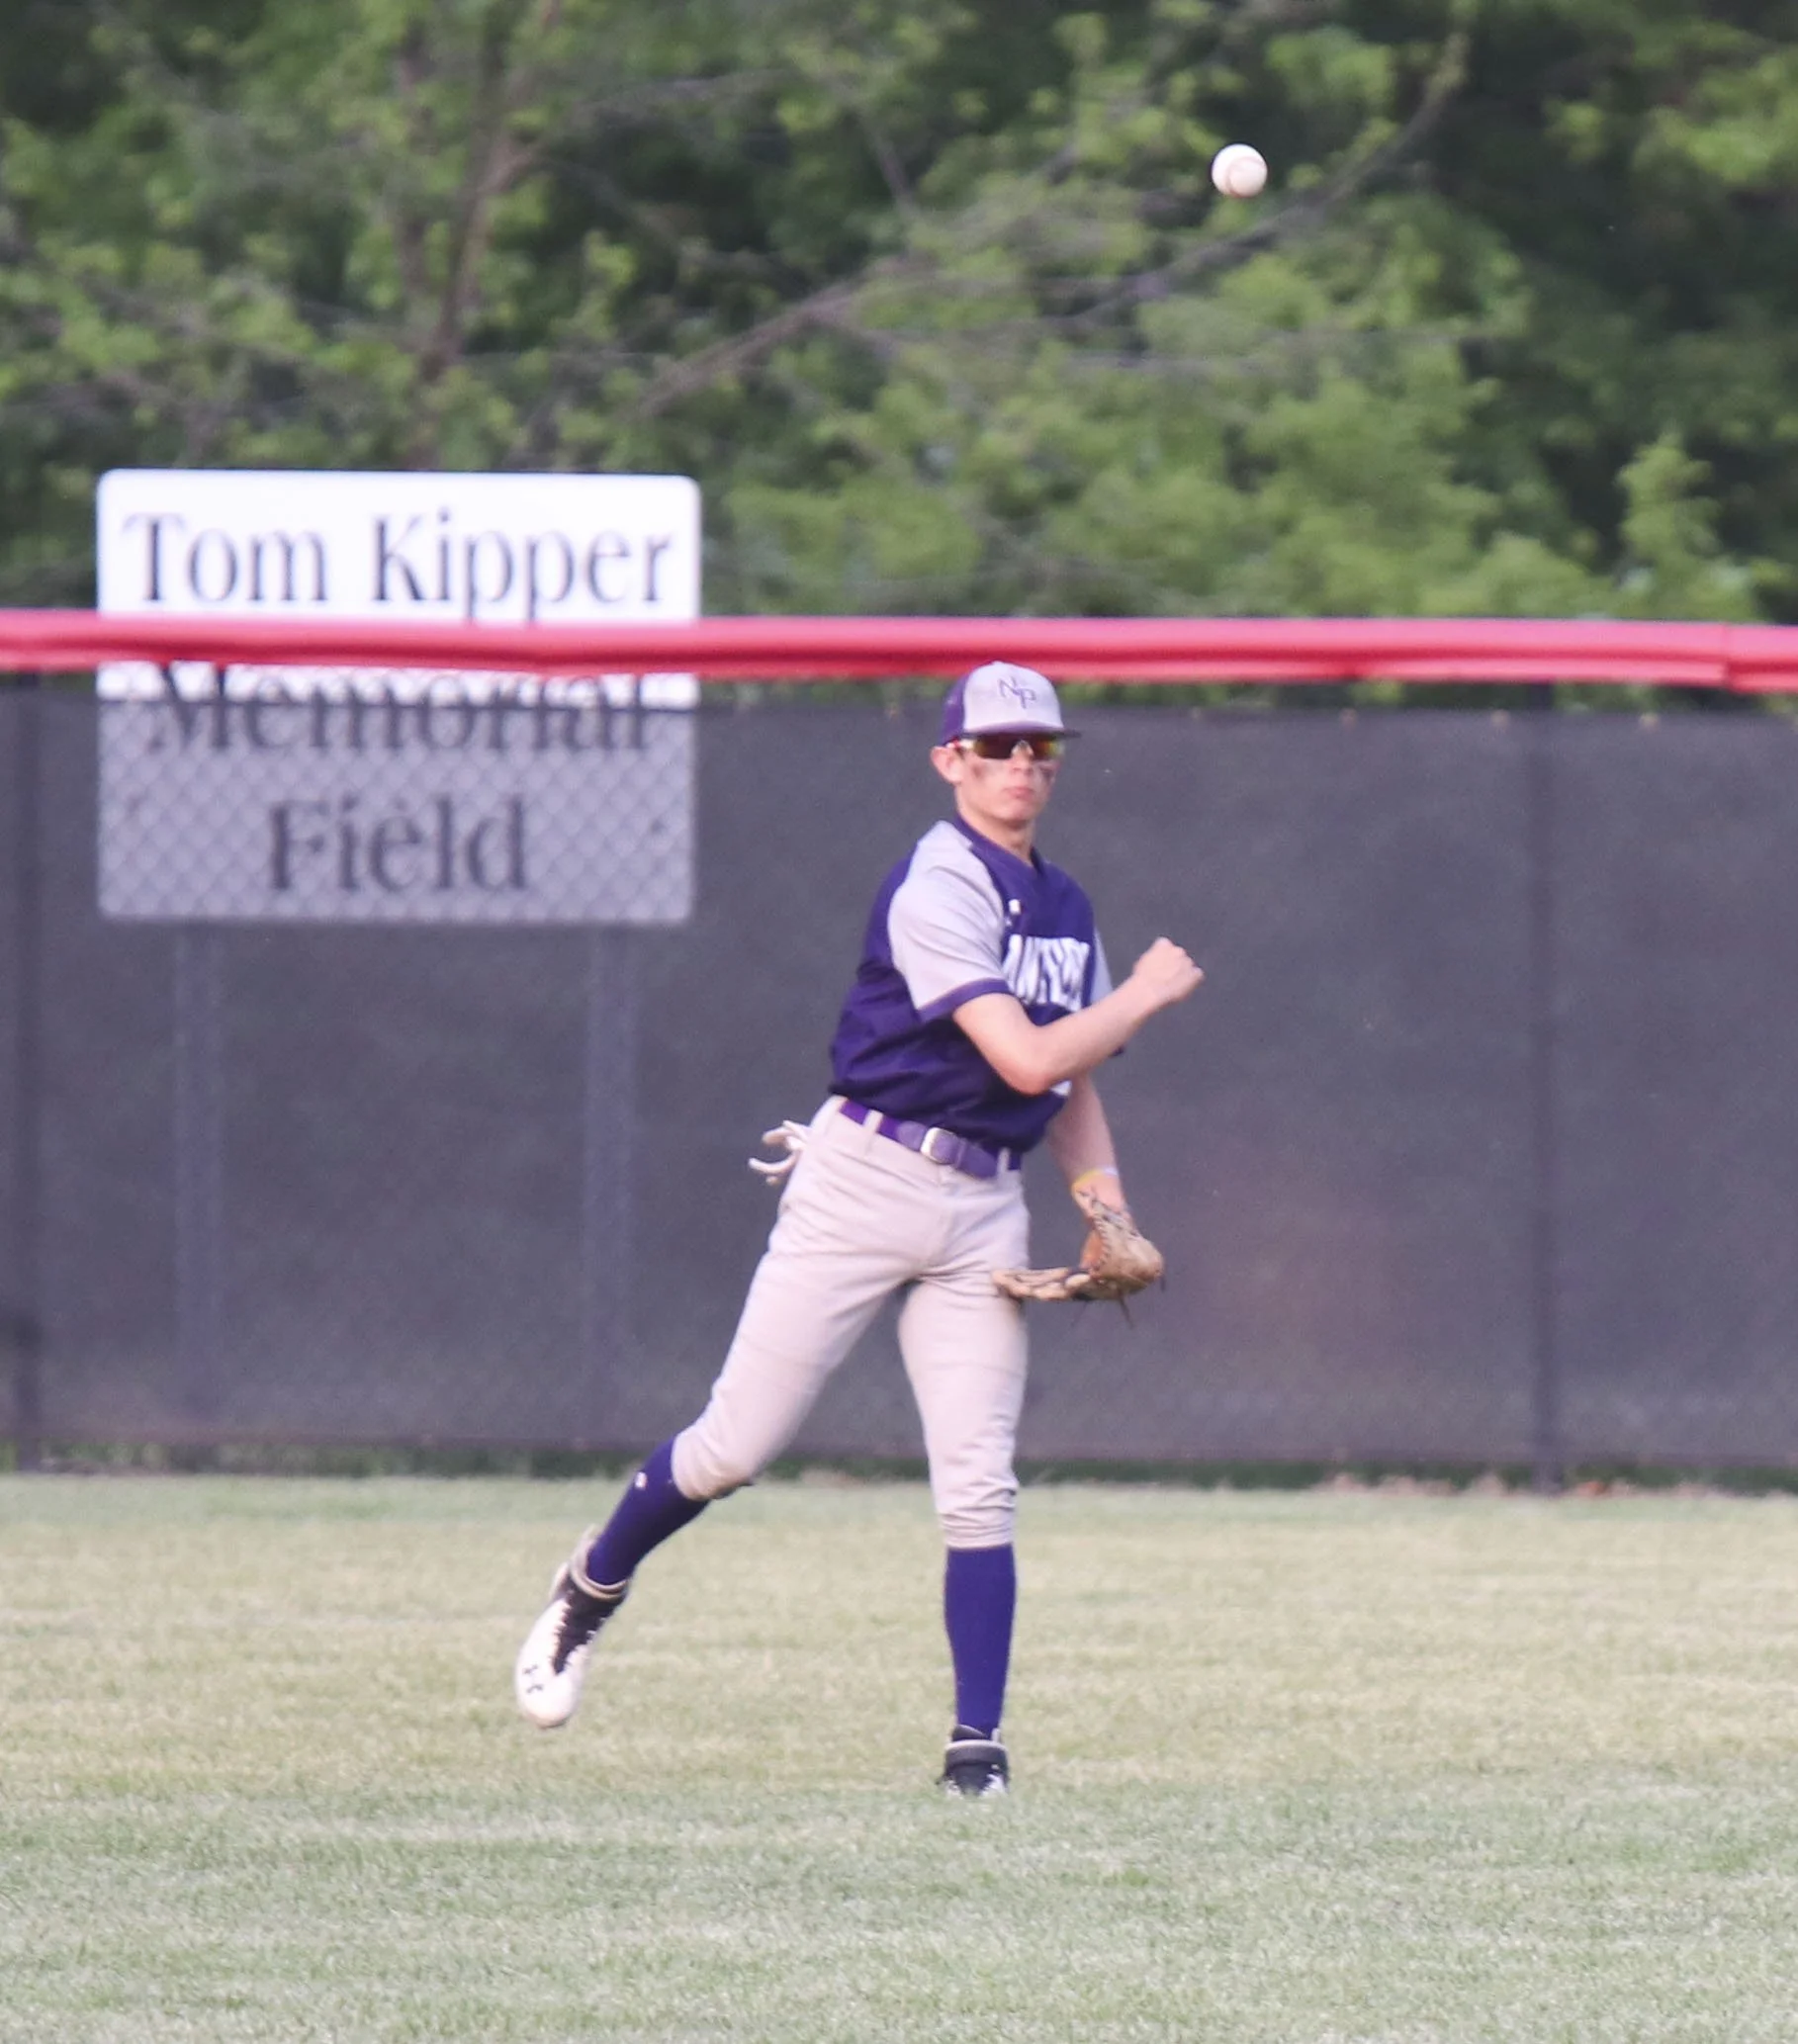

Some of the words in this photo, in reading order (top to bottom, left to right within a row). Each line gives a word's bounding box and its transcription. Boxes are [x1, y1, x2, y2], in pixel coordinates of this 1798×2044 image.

[123, 512, 327, 603] Tom
[371, 506, 674, 624] Kipper
[997, 675, 1036, 709] NP
[268, 795, 526, 891] Field
